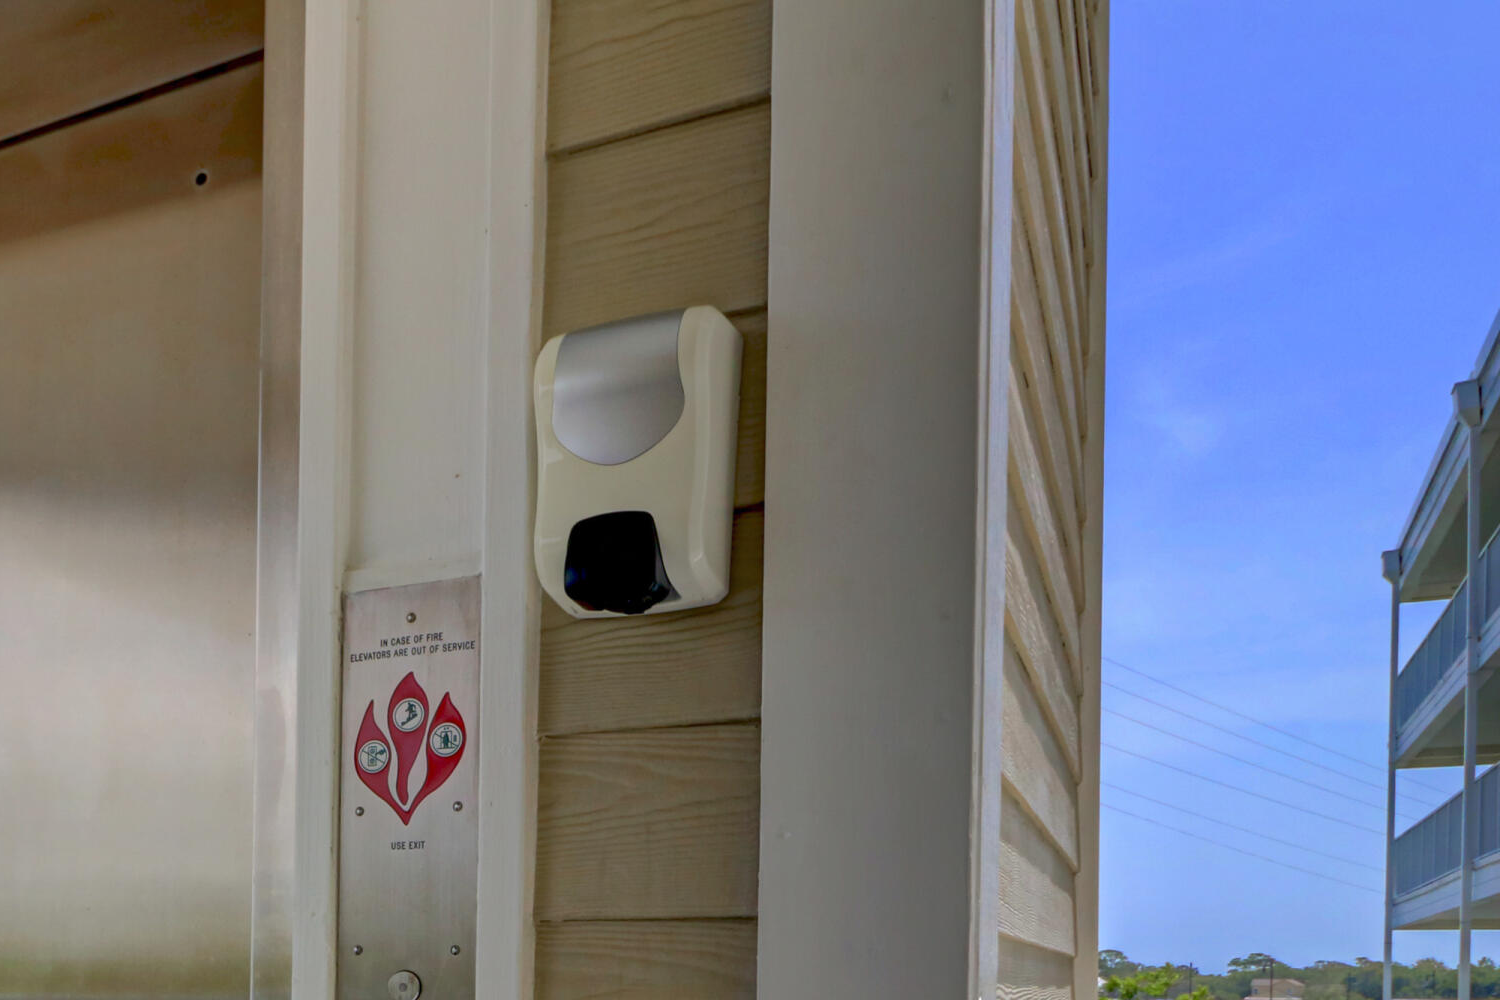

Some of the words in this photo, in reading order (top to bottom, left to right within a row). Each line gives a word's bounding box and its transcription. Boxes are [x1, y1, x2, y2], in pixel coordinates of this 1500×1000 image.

[380, 639, 388, 647] IN
[390, 636, 411, 646] CASE
[414, 633, 424, 643] OF
[426, 632, 443, 641] FIRE
[350, 650, 391, 663] ELEVATORS
[393, 648, 408, 657] ARE
[411, 646, 426, 655] OUT
[429, 644, 439, 654] OF
[442, 640, 476, 652] SERVICE
[391, 841, 406, 850] USE
[408, 841, 426, 850] EXIT
